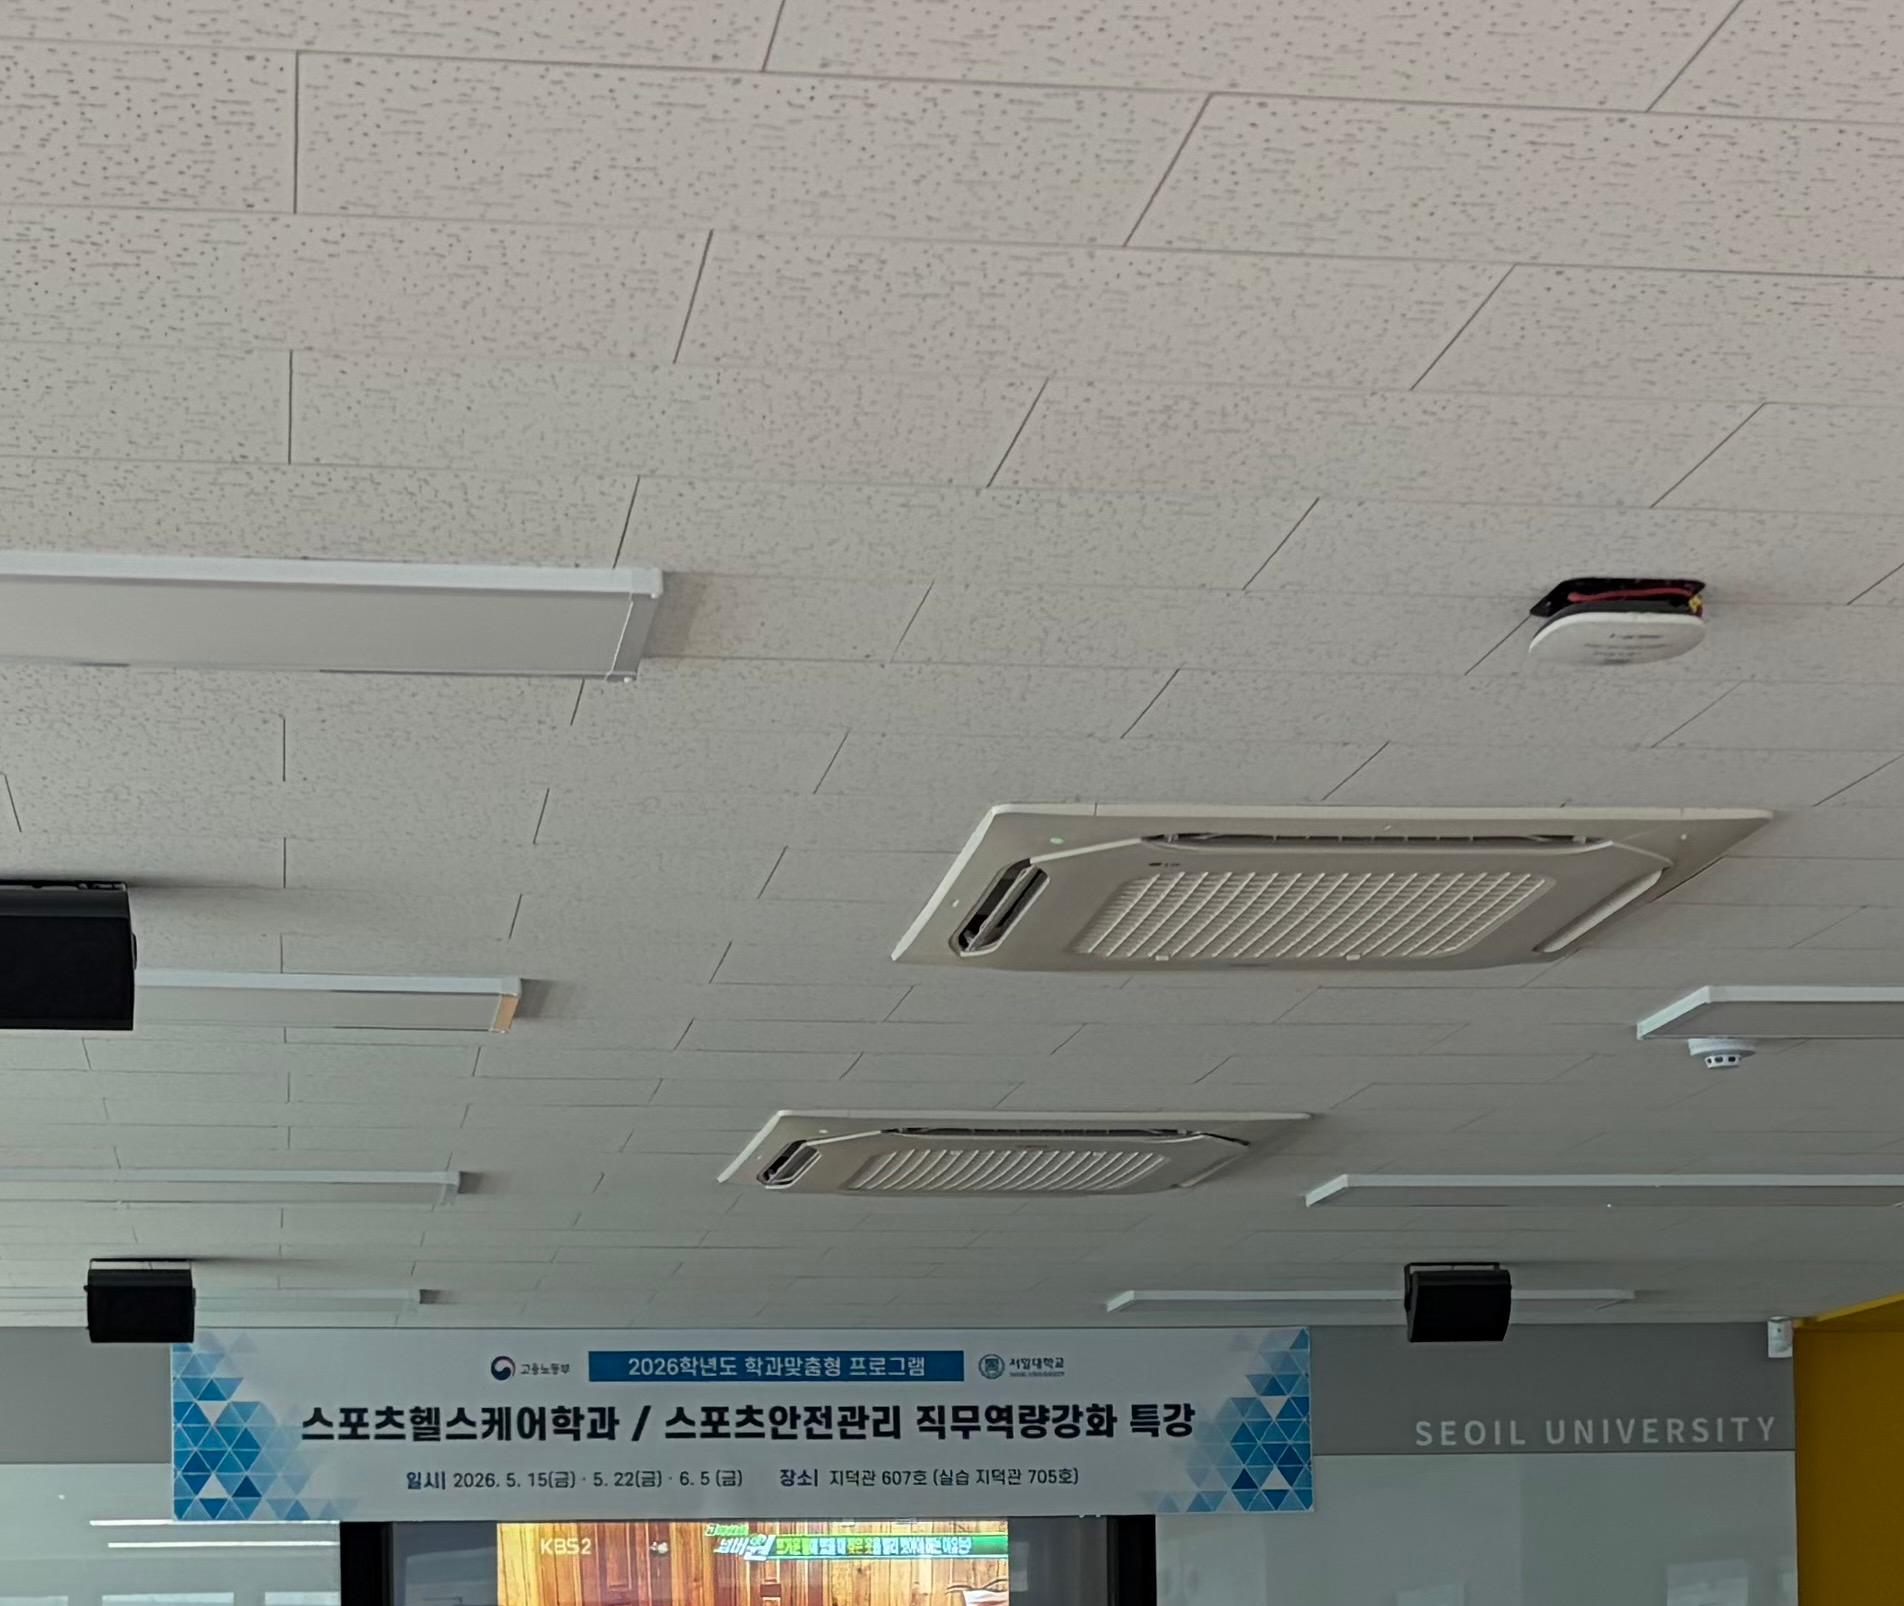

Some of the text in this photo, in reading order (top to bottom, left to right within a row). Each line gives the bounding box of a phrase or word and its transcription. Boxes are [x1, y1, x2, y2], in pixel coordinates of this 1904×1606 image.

[628, 1355, 925, 1377] 2026학년도 학과맞춤형 프로그램
[301, 1402, 1195, 1442] 스포츠헬스케어학과 / 스포츠안전관리 직무역량강화 특강
[1415, 1417, 1776, 1446] SEOIL UNIVERSITY
[453, 1473, 500, 1488] 2026.
[506, 1473, 523, 1488] 5.
[527, 1472, 576, 1489] 15(금)
[593, 1473, 610, 1488] 5.
[613, 1472, 663, 1489] 22(금)
[715, 1470, 743, 1488] (금)
[829, 1470, 876, 1487] 지덕관
[882, 1470, 927, 1486] 607호
[933, 1468, 970, 1487] (실습
[975, 1468, 1023, 1486] 지덕관
[1027, 1467, 1079, 1486] 705호)
